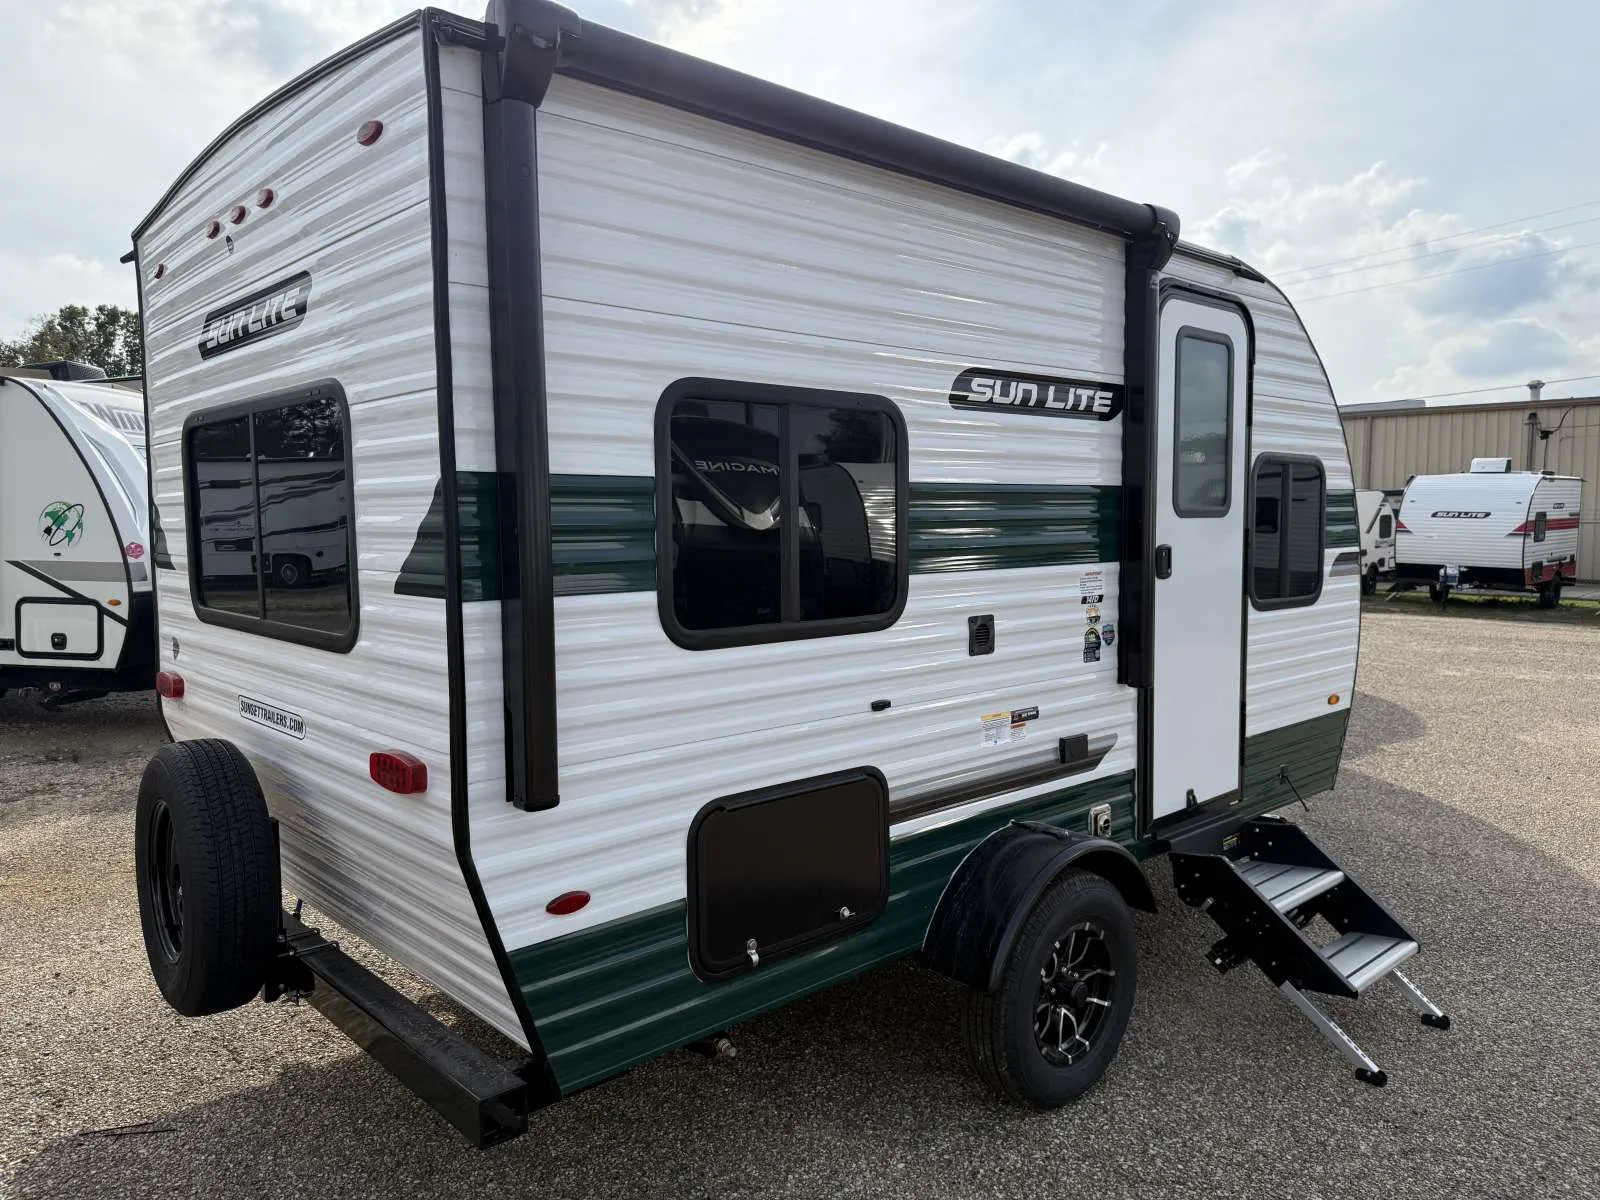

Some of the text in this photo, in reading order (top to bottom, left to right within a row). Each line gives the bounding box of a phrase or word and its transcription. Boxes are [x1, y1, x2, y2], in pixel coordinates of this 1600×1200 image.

[203, 287, 300, 349] SUN LITE
[967, 377, 1113, 414] SUN LITE
[240, 700, 304, 734] SUNSETTRAILERS.COM
